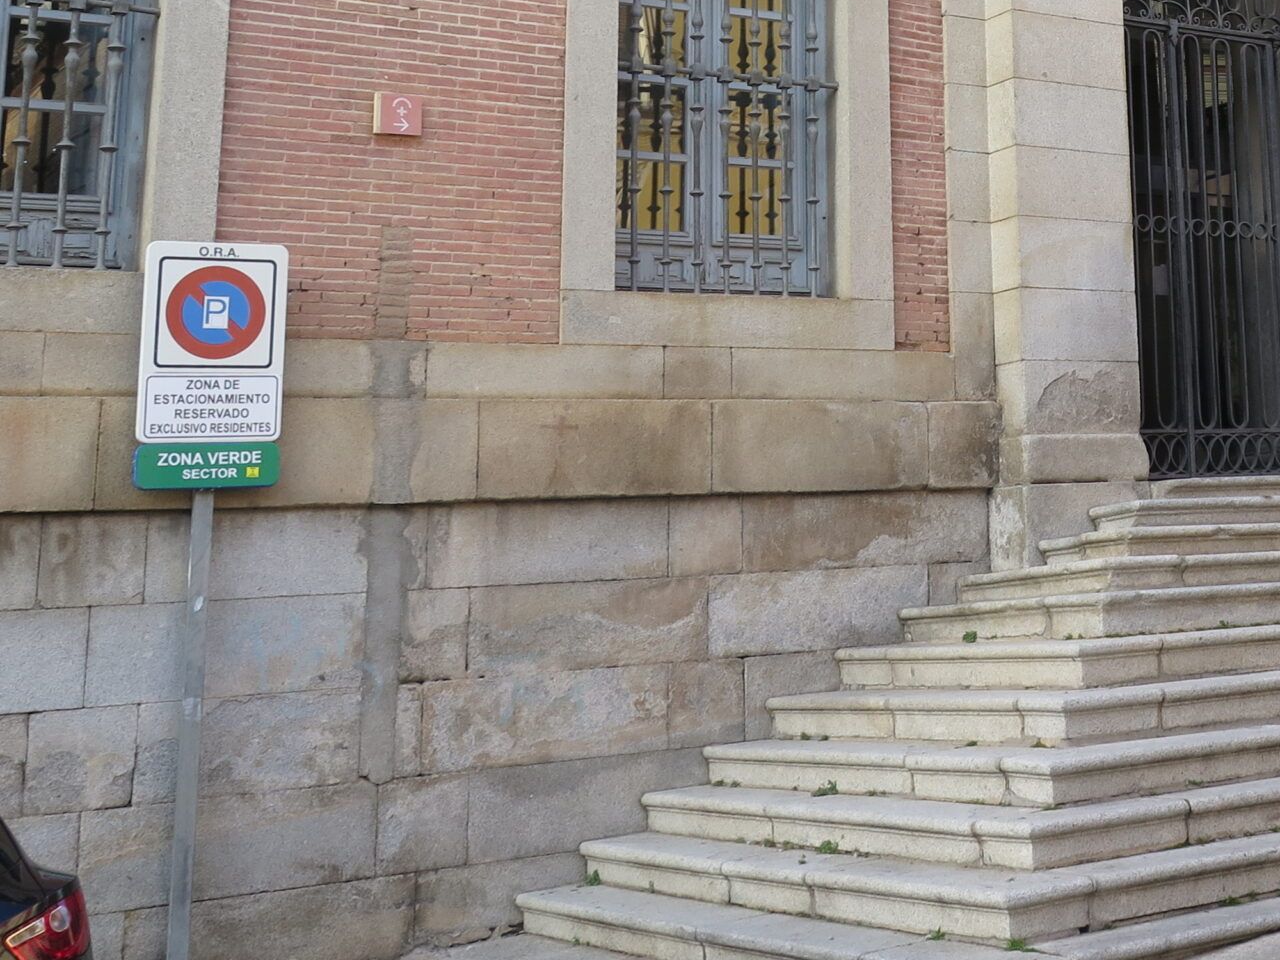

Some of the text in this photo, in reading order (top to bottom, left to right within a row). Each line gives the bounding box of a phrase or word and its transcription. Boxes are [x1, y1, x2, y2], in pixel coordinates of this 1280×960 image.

[199, 246, 240, 259] O.R.A.
[204, 298, 227, 325] P
[186, 379, 241, 391] ZONA DE
[153, 393, 271, 405] ESTACIONAMIENTO
[173, 407, 250, 420] RESERVADO
[150, 421, 272, 435] EXCLUSIVO RESIDENTES
[157, 450, 263, 467] ZONA VERDE
[181, 467, 238, 480] SECTOR
